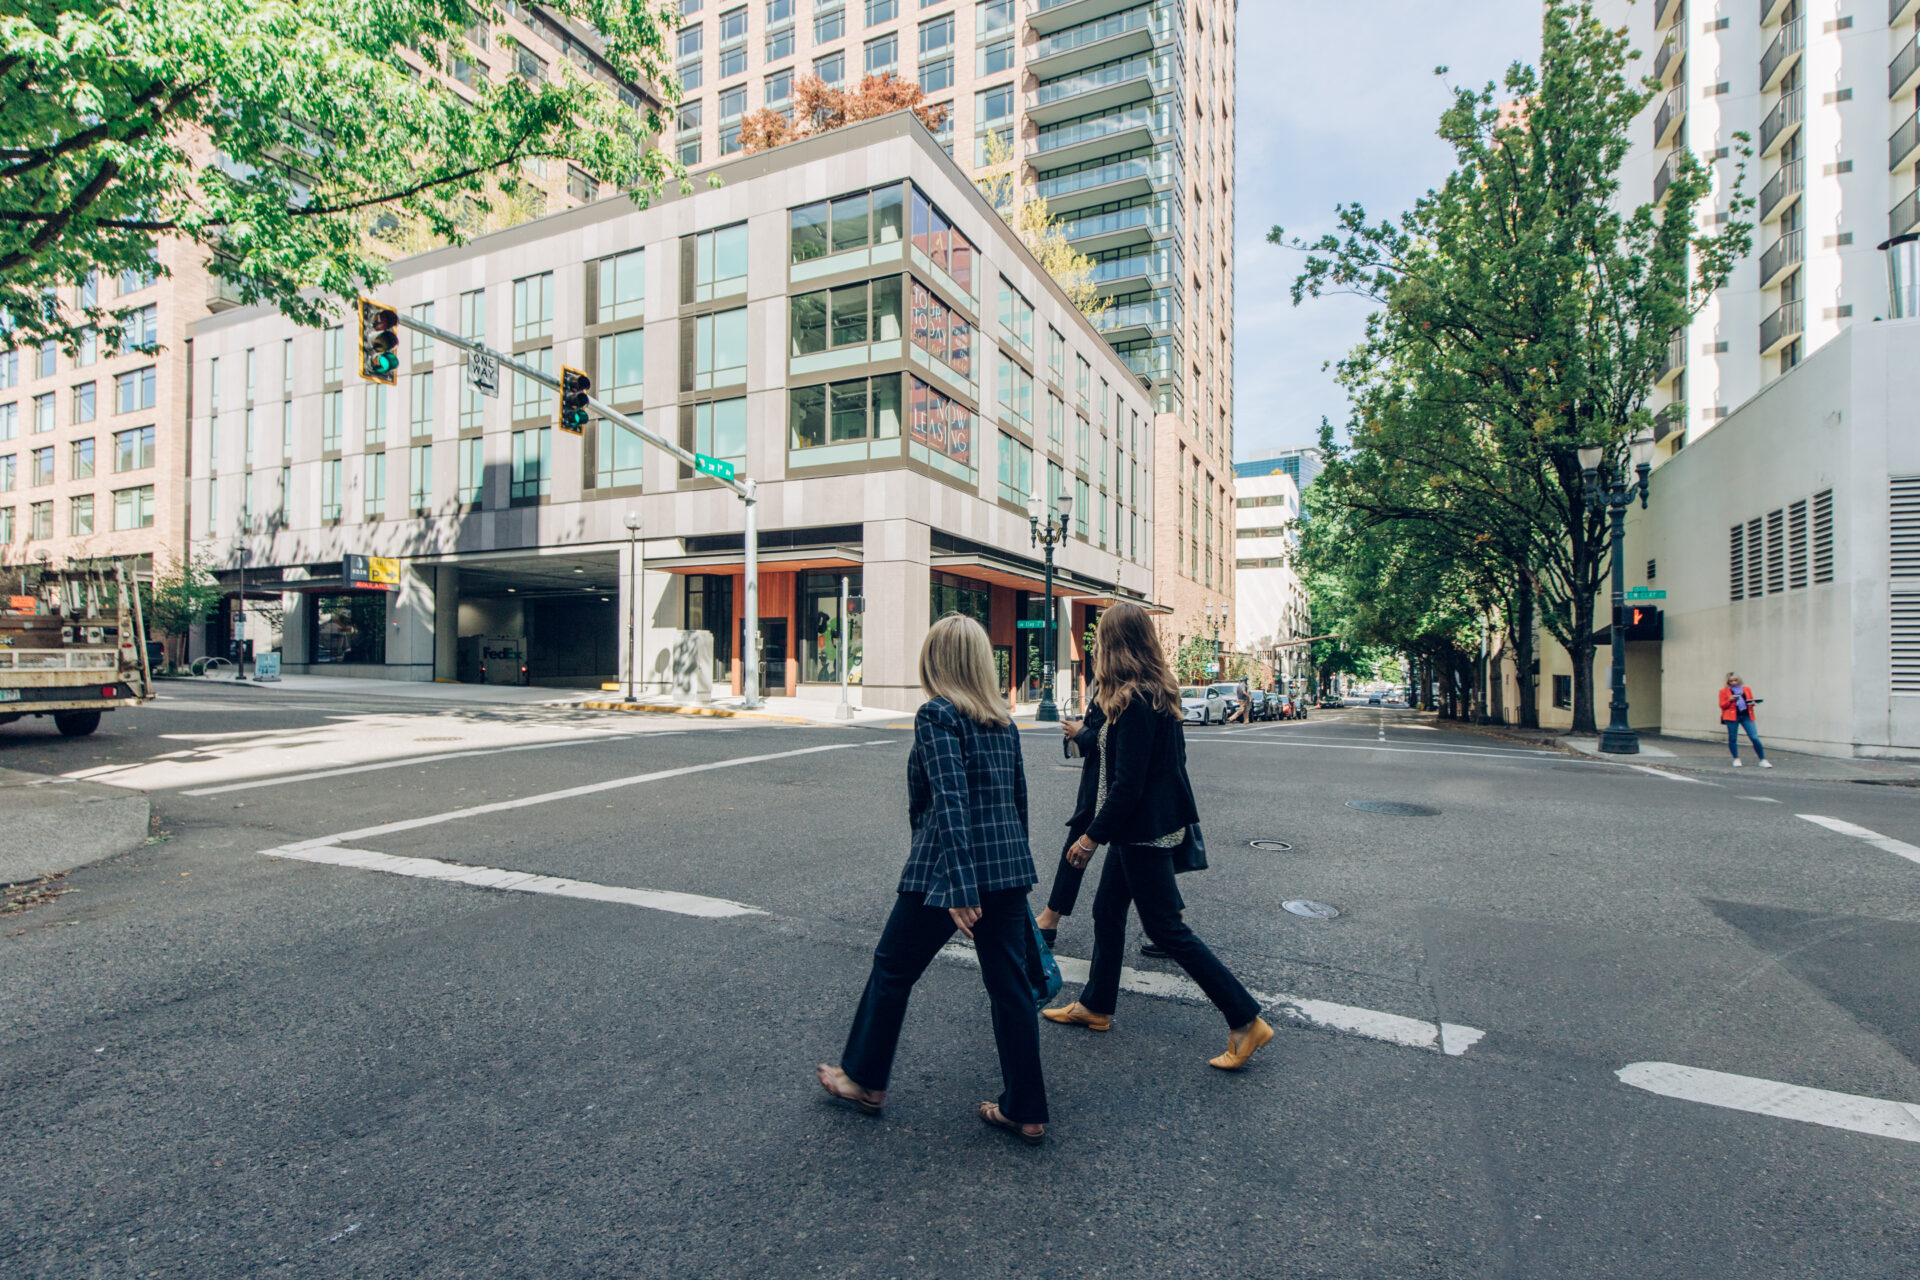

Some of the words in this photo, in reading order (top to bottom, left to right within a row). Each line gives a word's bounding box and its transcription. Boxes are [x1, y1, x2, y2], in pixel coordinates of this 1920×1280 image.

[473, 353, 494, 369] ONE
[472, 364, 495, 379] WAY
[936, 397, 967, 430] NOW
[914, 407, 967, 452] LEASING
[371, 570, 380, 580] P
[483, 646, 523, 660] FedEx
